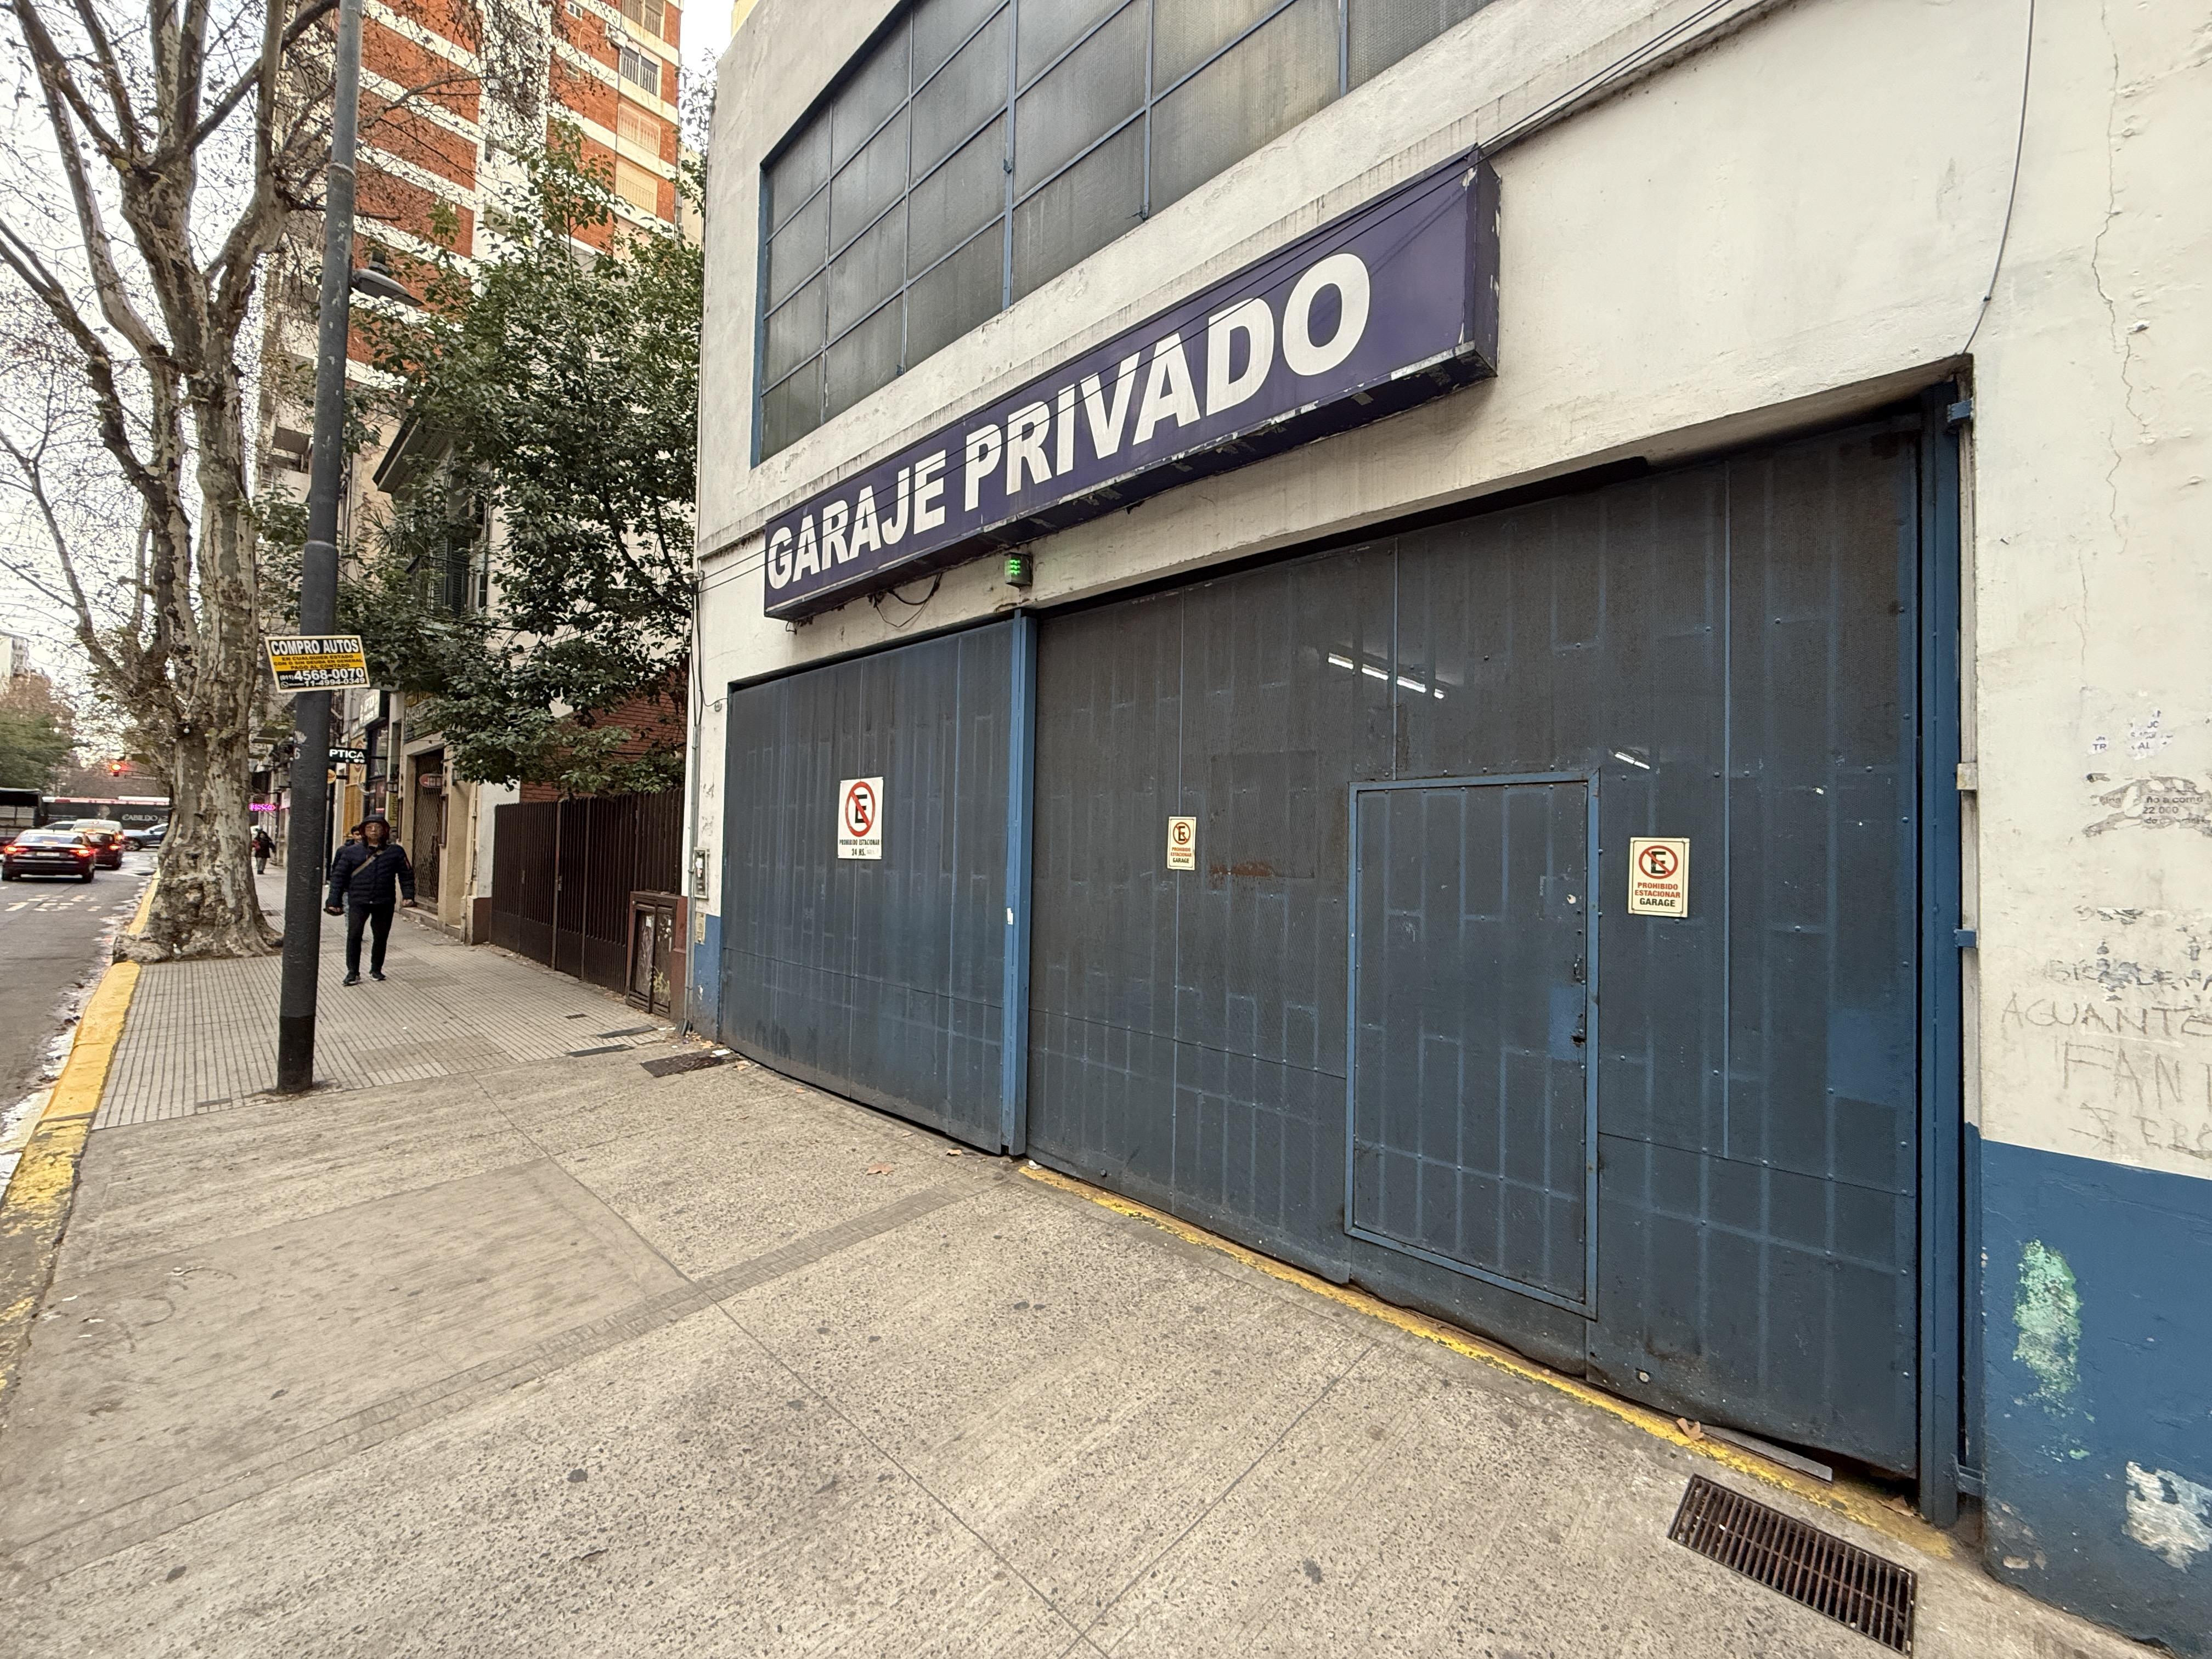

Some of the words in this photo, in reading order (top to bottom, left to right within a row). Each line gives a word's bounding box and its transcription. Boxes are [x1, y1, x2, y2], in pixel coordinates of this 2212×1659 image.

[767, 449, 947, 589] GARAJE
[963, 253, 1370, 512] PRIVADO
[270, 640, 320, 655] COMPRO
[323, 639, 359, 653] AUTOS
[294, 668, 364, 681] 4568-0070
[304, 678, 365, 687] 11-4994-0349
[329, 749, 365, 759] PTICA
[1638, 882, 1678, 890] PROHIBIDO
[1635, 890, 1680, 898] ESTACIONAR
[1640, 898, 1675, 907] GARAGE
